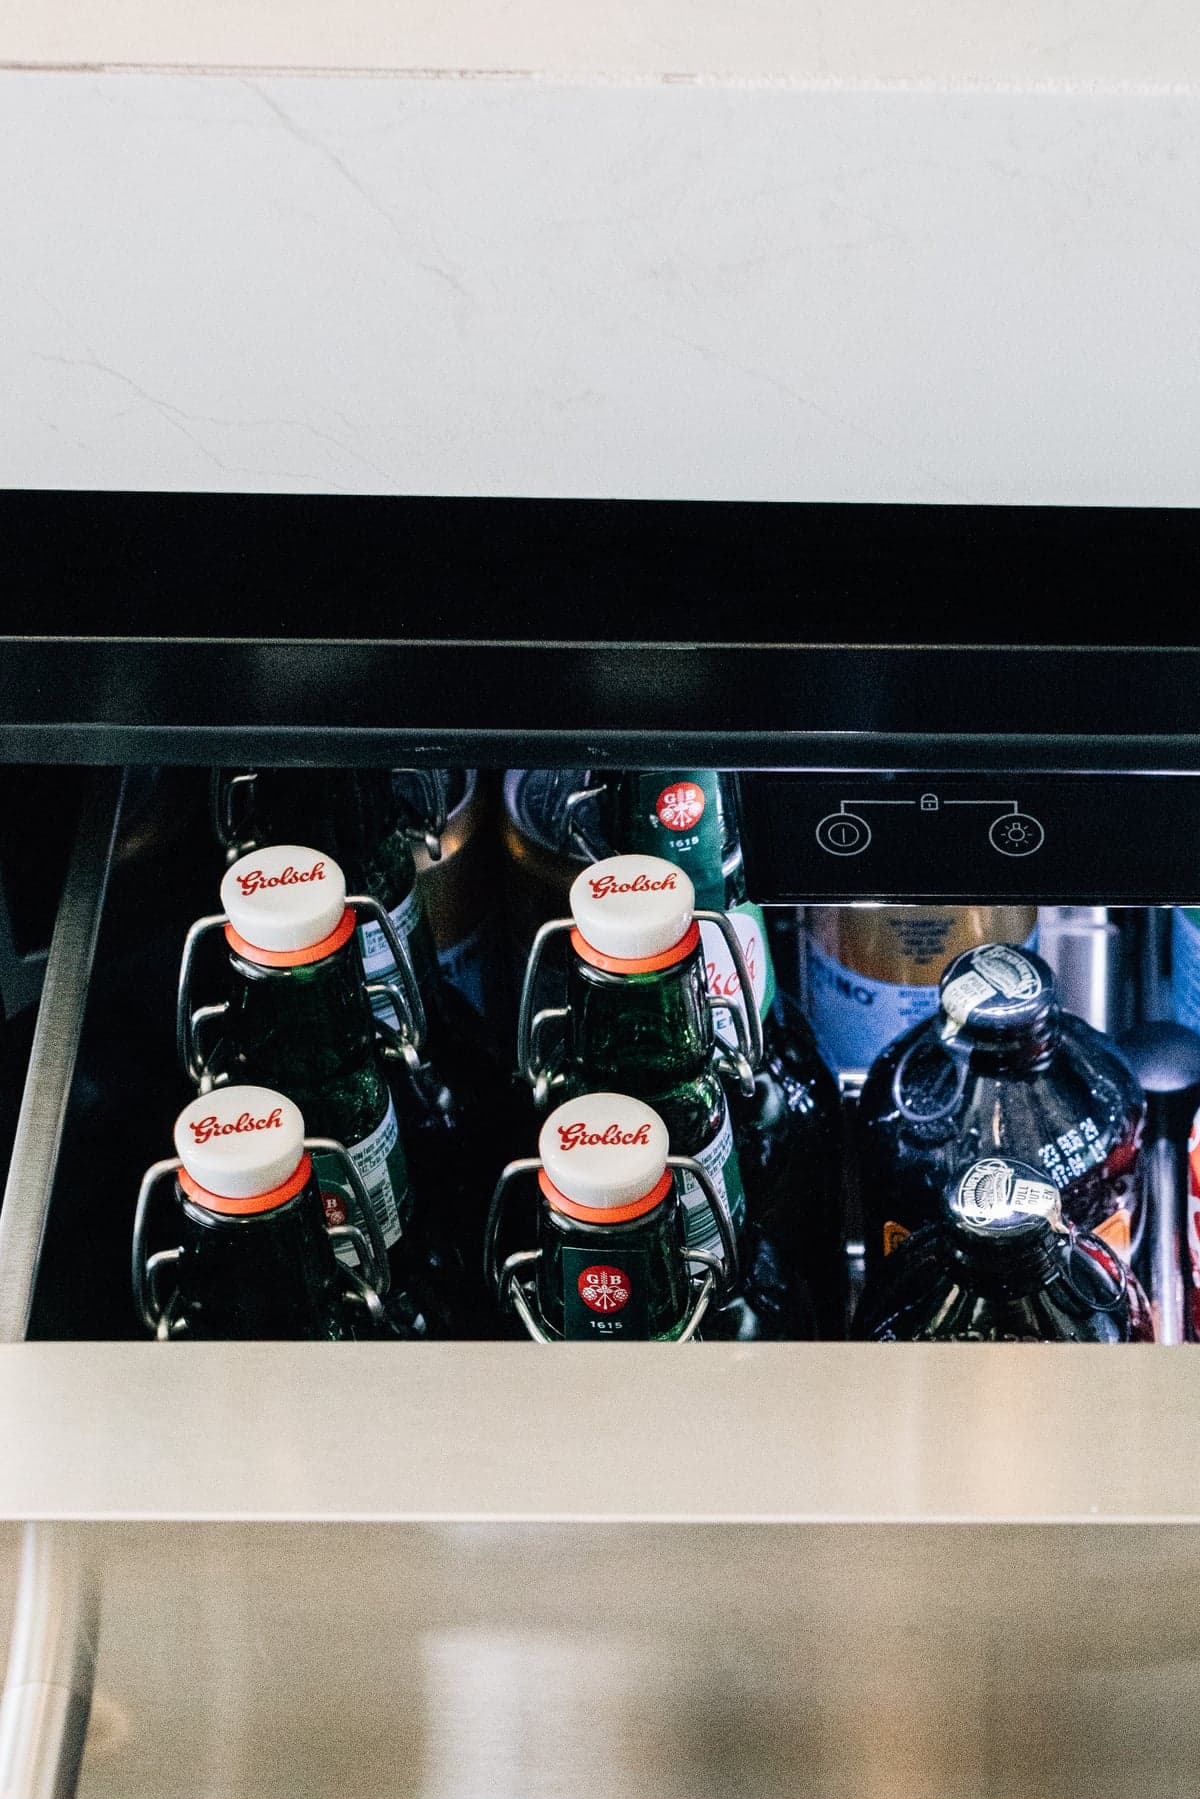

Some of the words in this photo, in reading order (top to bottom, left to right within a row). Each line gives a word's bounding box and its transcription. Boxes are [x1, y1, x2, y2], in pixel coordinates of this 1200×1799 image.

[684, 789, 697, 801] B
[236, 861, 326, 896] Grolsch
[588, 872, 678, 899] Grolsch
[189, 1107, 283, 1144] Grolsch
[557, 1122, 652, 1151] Grolsch
[1015, 1184, 1029, 1206] PULL
[586, 1273, 599, 1285] G
[609, 1275, 622, 1285] B
[589, 1320, 624, 1330] 1615
